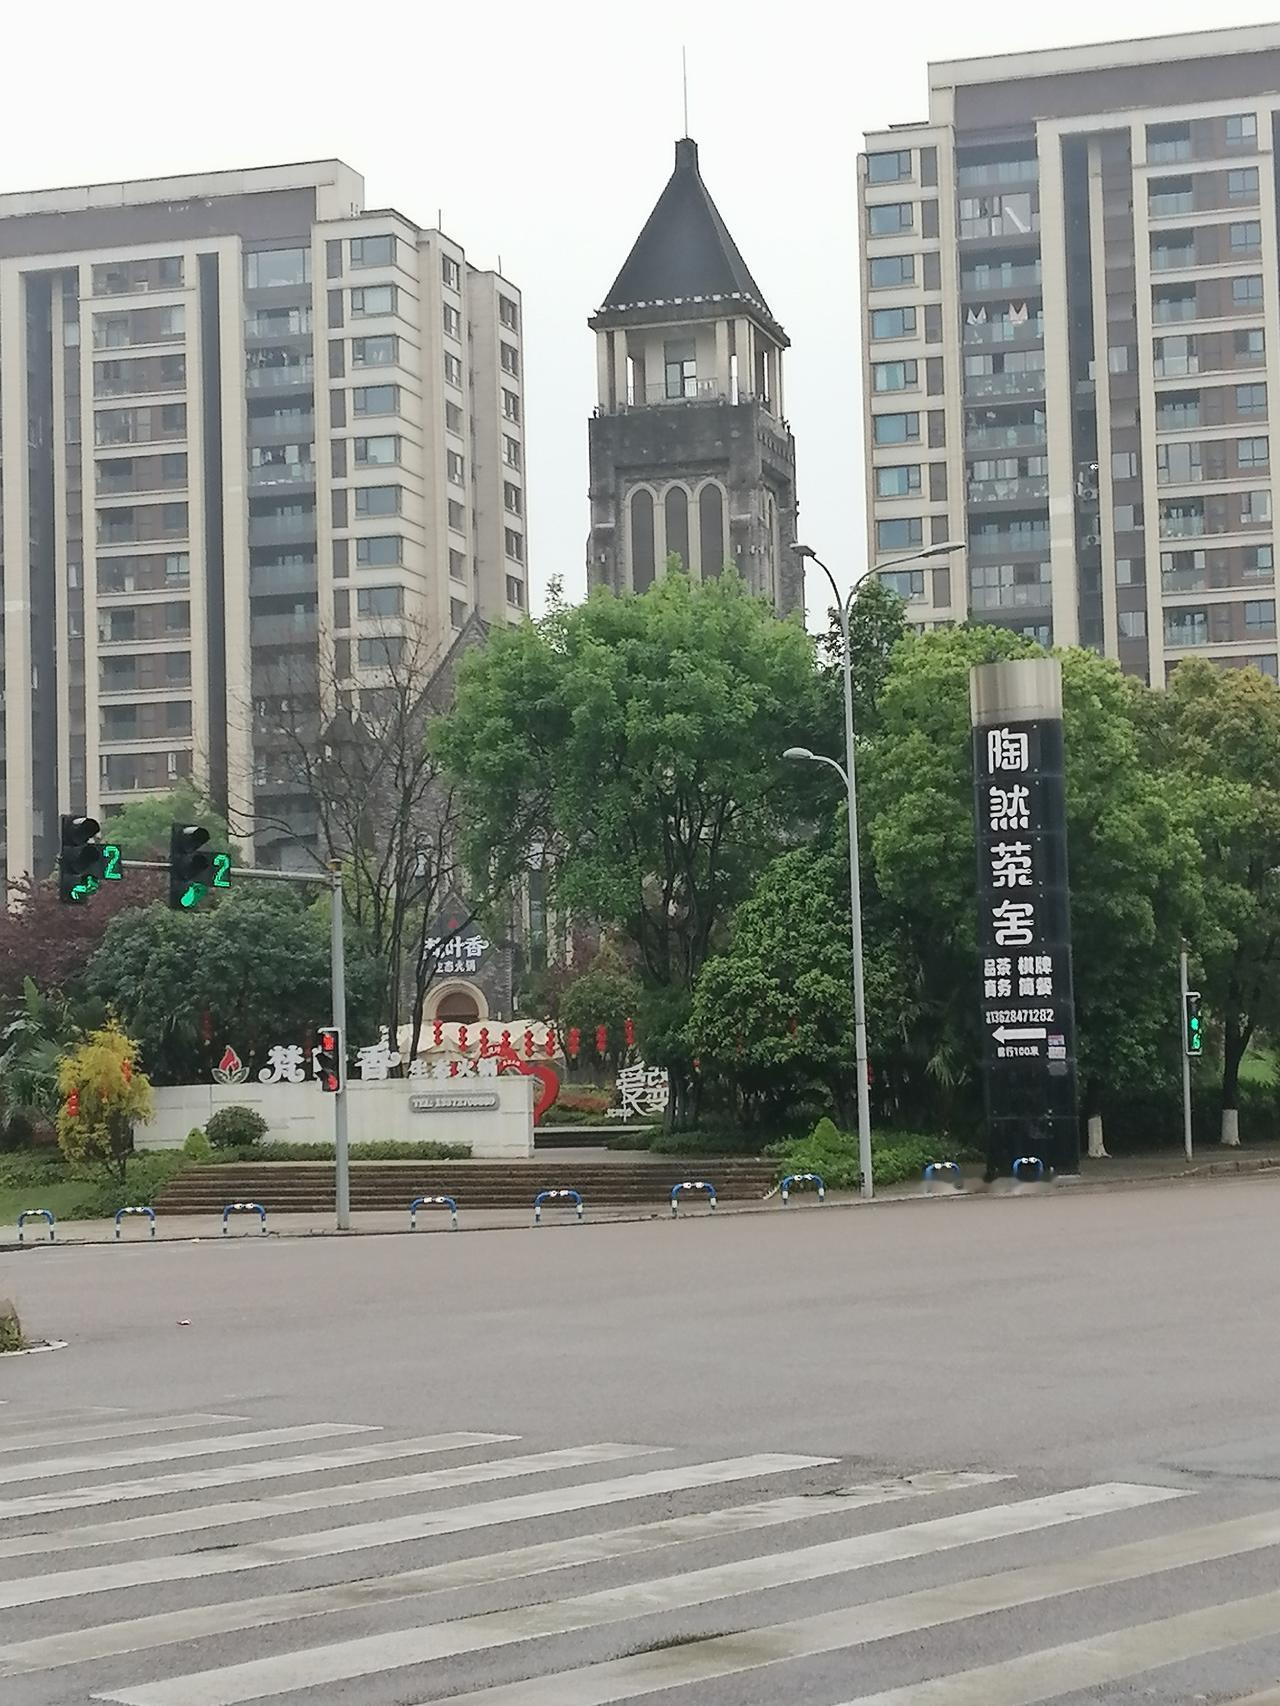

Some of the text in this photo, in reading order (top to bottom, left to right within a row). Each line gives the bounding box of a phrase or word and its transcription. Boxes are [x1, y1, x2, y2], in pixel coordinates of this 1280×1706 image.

[987, 727, 1035, 946] 陶然茶舍
[103, 845, 122, 879] 2
[213, 854, 232, 887] 2
[984, 955, 1053, 977] 品茶 棋牌
[984, 978, 1012, 998] 商务
[258, 1041, 401, 1083] 梵香
